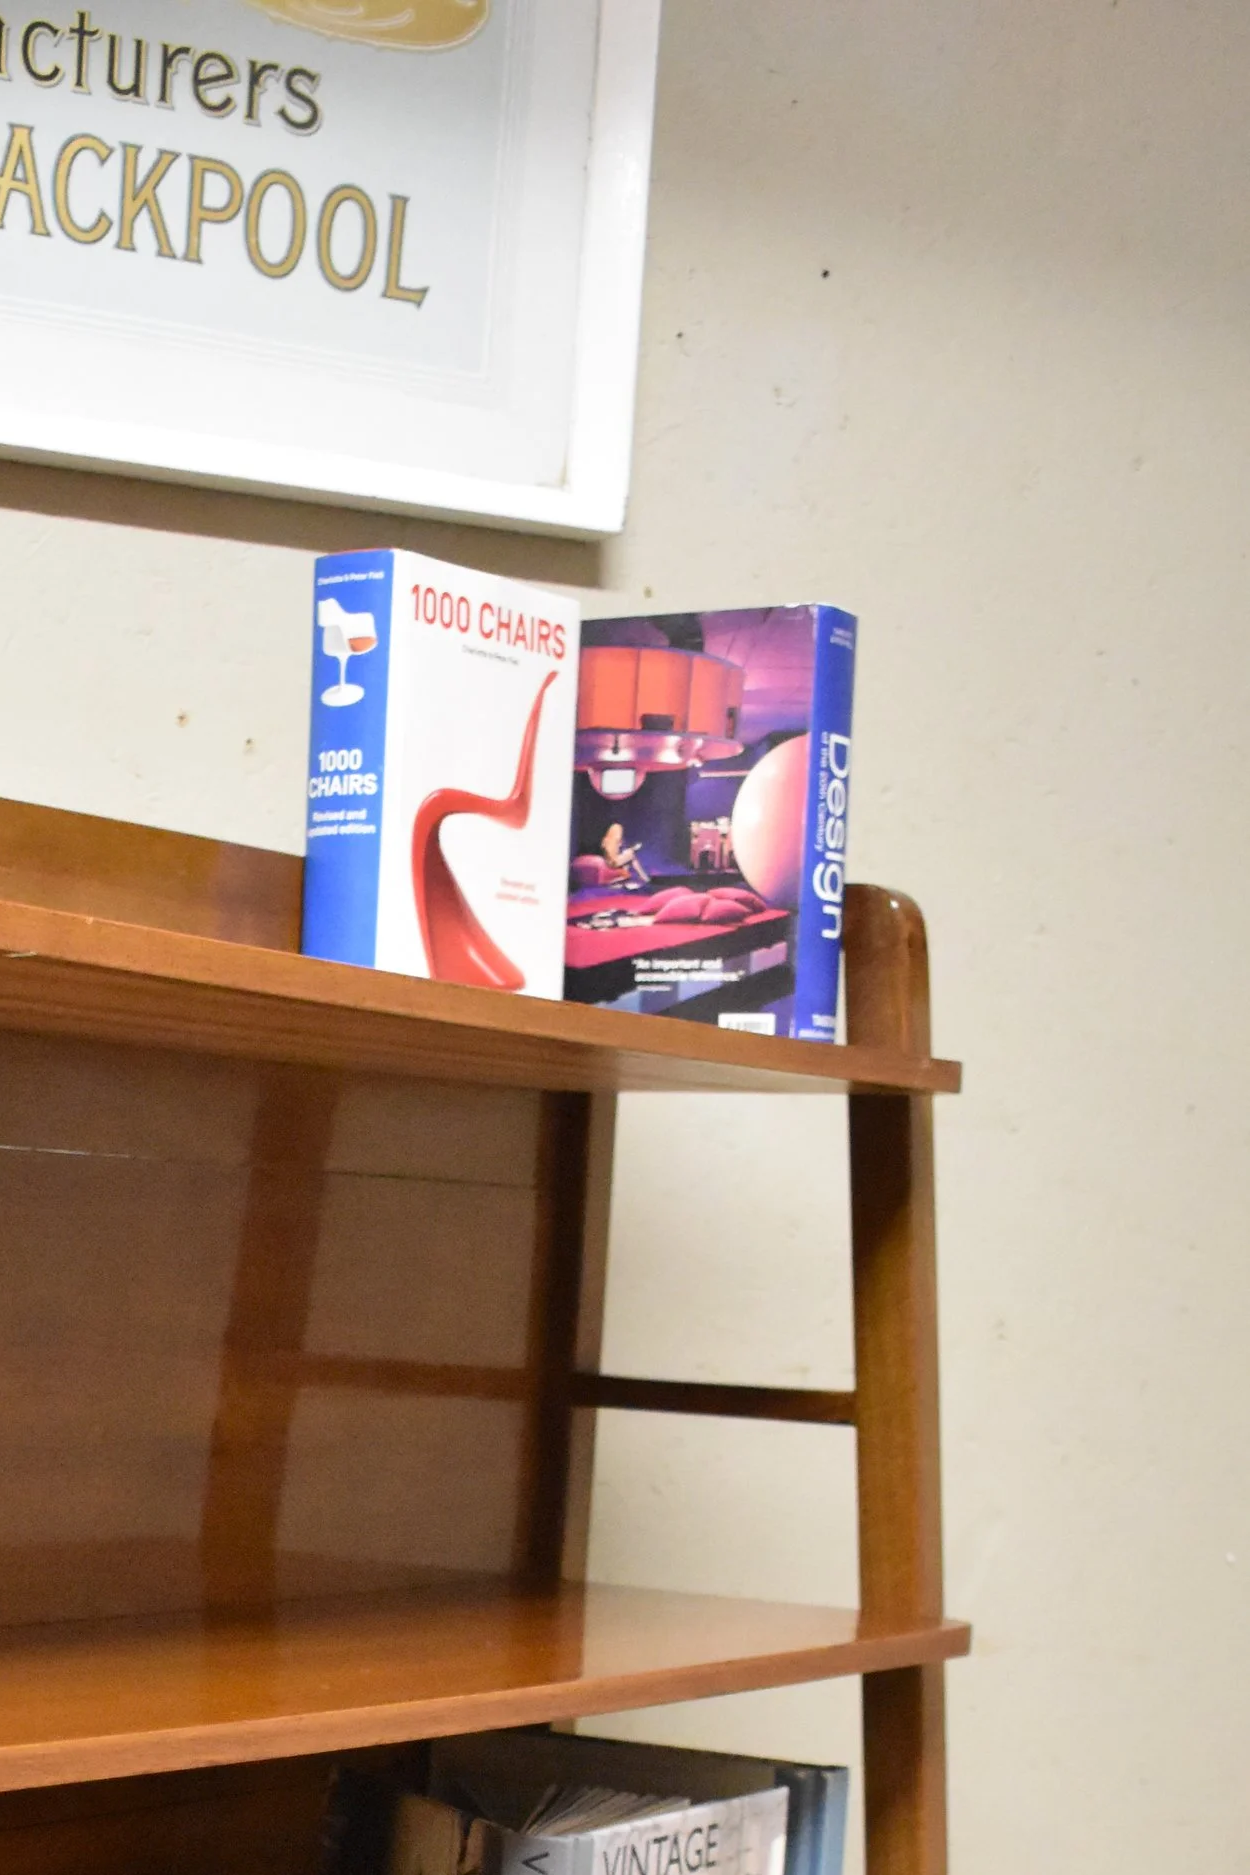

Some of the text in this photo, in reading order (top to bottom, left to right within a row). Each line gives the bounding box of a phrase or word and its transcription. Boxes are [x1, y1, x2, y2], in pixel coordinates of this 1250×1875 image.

[411, 584, 471, 633] 1000
[478, 602, 566, 660] CHAIRS
[308, 773, 378, 799] CHAIRS
[318, 748, 362, 773] 1000
[812, 733, 851, 940] Design
